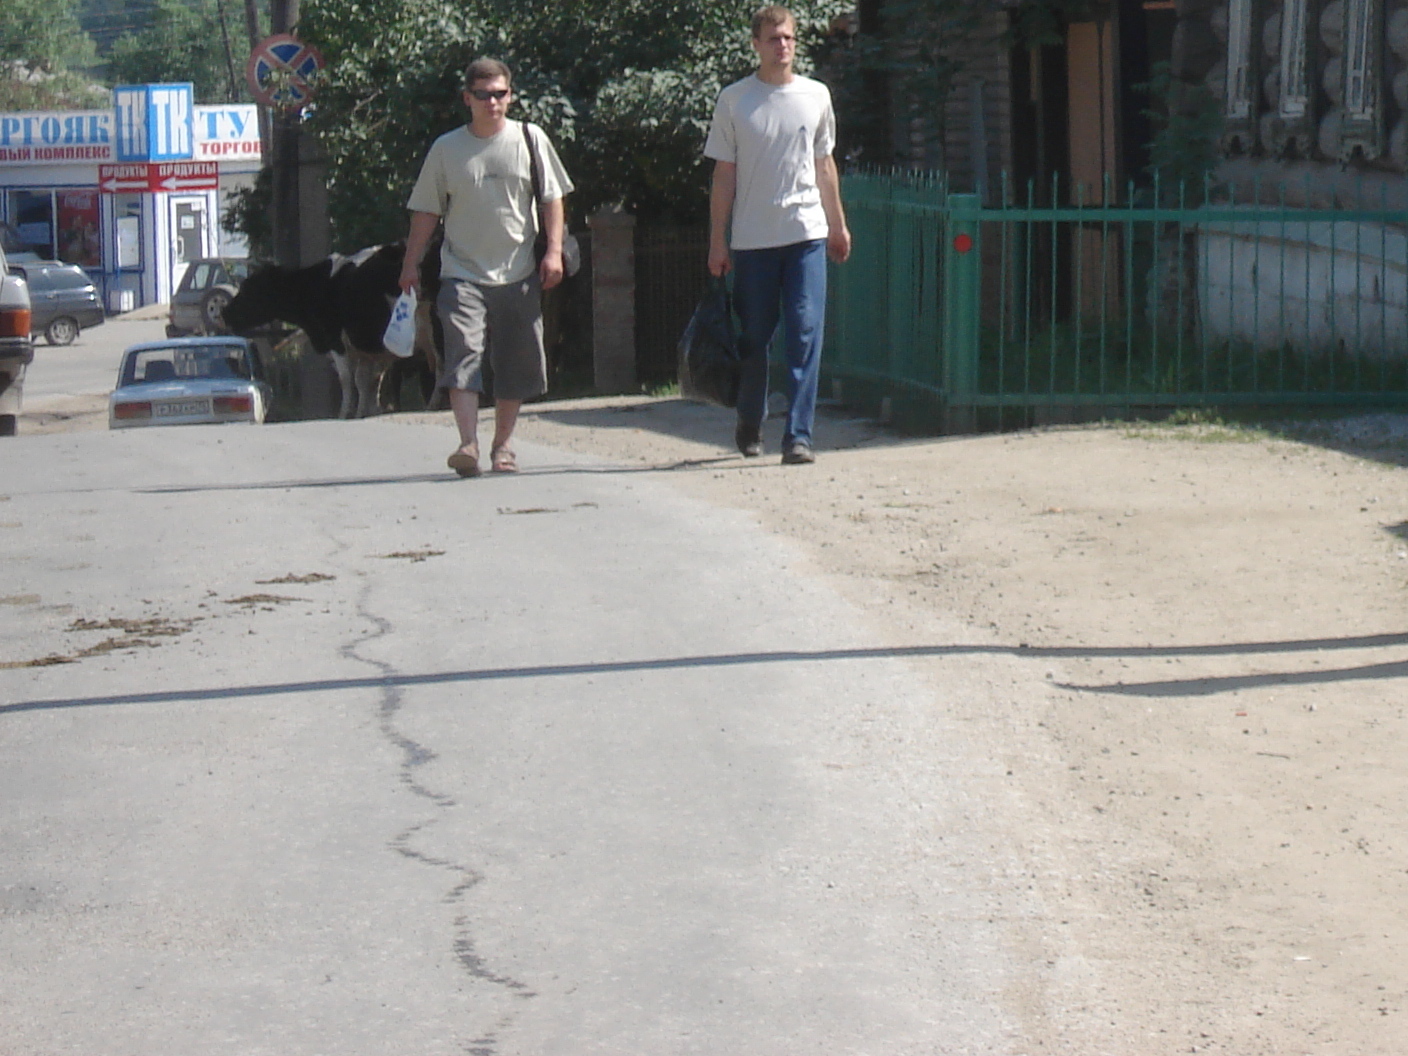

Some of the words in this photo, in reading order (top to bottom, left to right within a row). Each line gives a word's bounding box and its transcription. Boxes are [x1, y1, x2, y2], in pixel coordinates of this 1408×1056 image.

[117, 90, 148, 156] ТК
[152, 89, 189, 155] ТК
[199, 111, 260, 139] ТУ
[34, 146, 110, 160] КОМПЛЕКС
[102, 166, 148, 177] ПРОДУКТЫ
[159, 163, 216, 176] ПРОДУКТЫ
